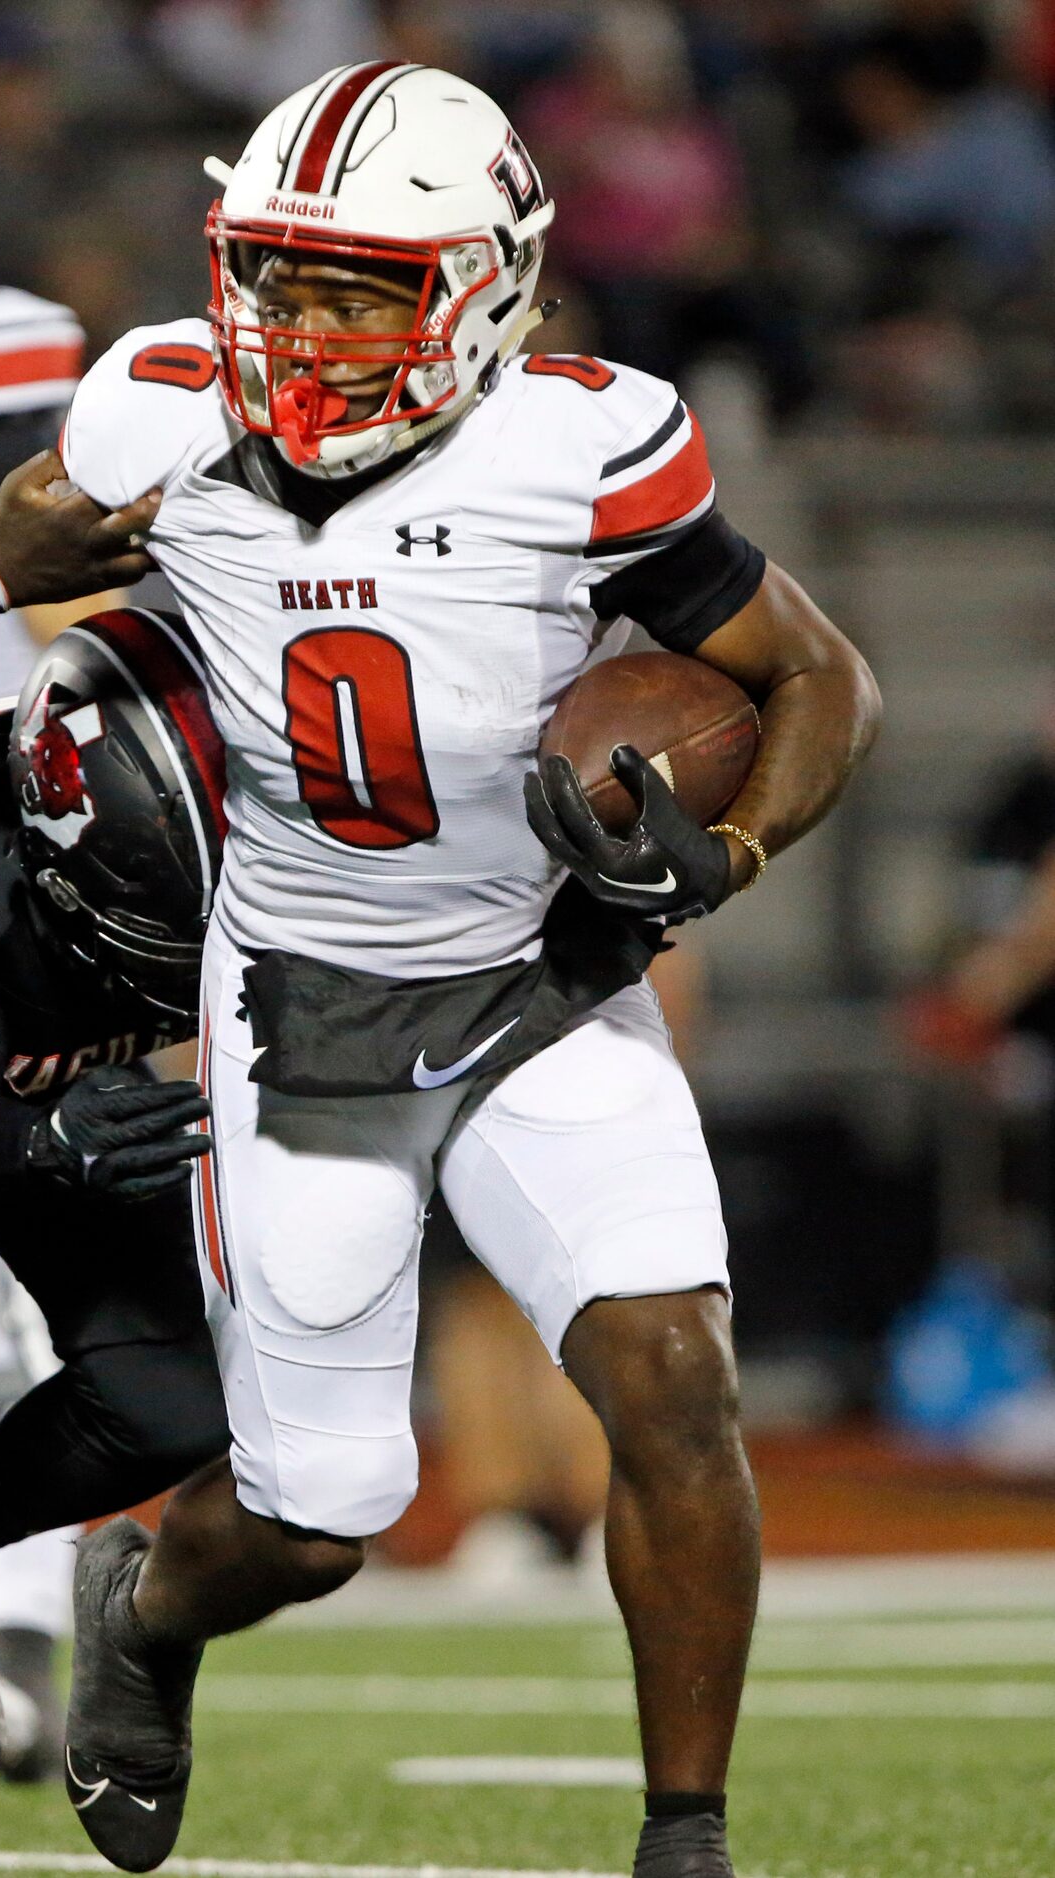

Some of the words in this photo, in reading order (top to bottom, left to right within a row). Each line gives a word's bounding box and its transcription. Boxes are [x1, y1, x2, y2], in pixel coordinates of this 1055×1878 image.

[265, 195, 336, 220] Riddell
[128, 342, 220, 393] 0
[278, 577, 379, 610] HEATH
[281, 625, 441, 851] 0
